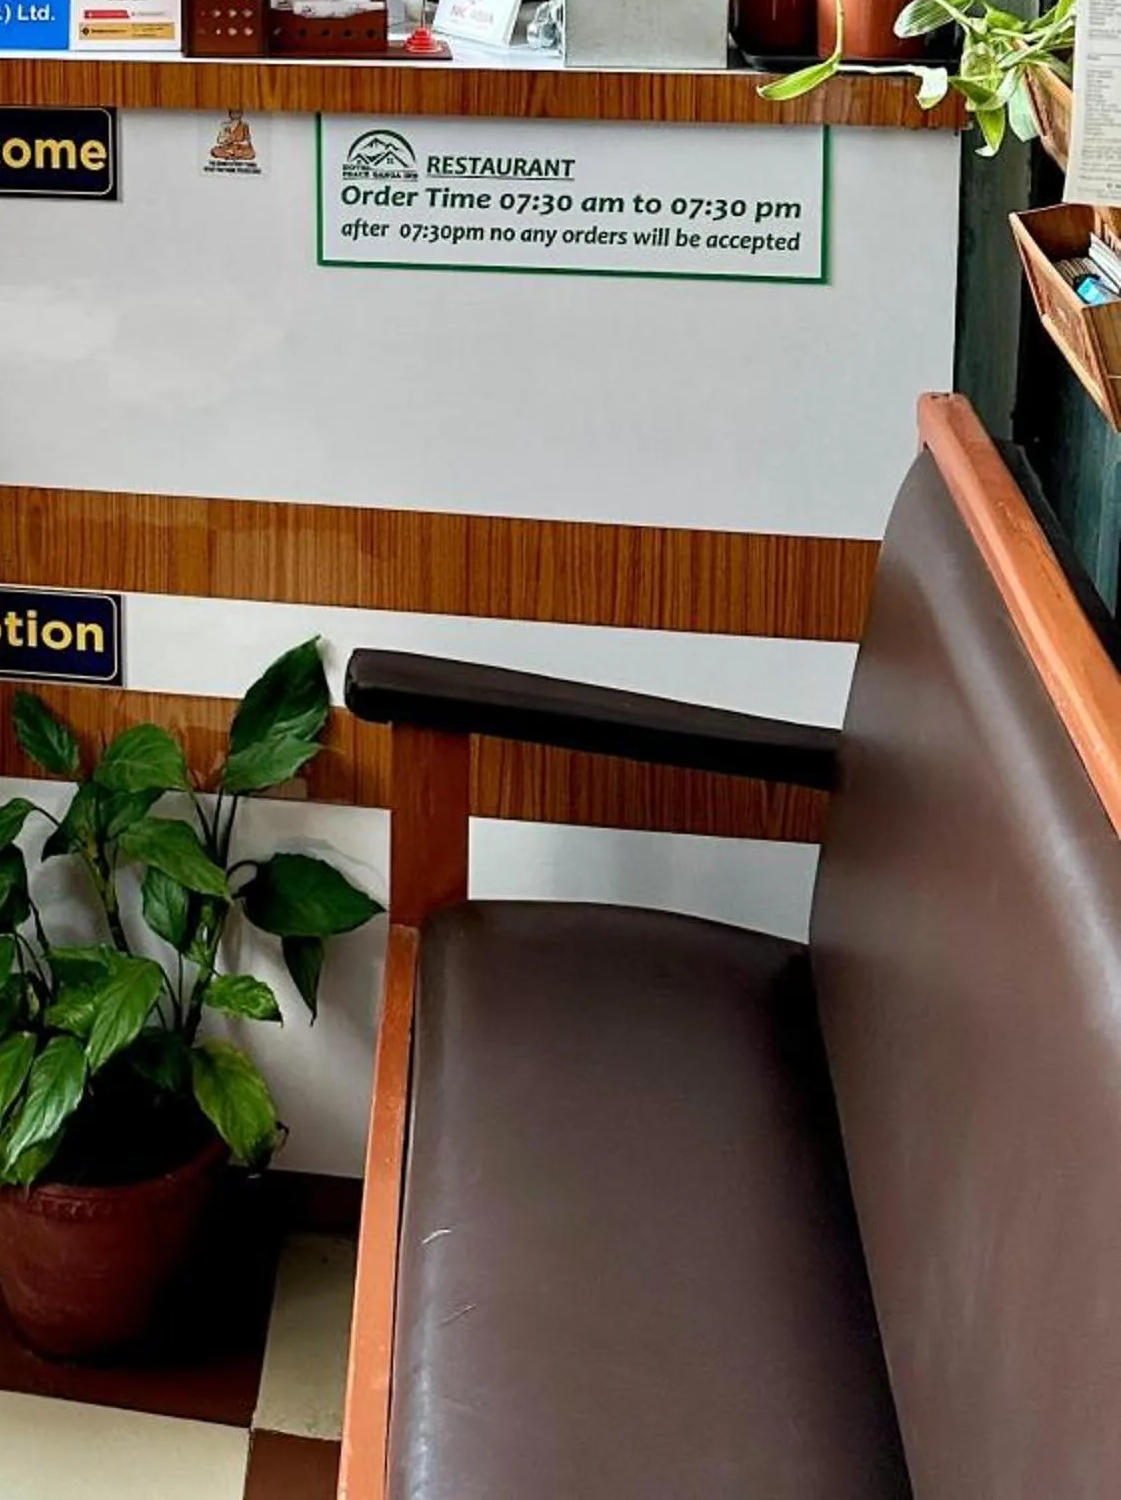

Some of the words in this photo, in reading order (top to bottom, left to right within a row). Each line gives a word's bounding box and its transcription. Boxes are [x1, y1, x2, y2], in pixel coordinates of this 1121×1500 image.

[17, 3, 56, 22] Ltd.
[426, 155, 576, 178] RESTAURANT
[340, 185, 419, 207] Order
[425, 187, 492, 209] Time
[499, 192, 574, 215] 07:30
[581, 195, 625, 213] am
[633, 193, 663, 214] to
[670, 198, 747, 221] 07:30
[754, 200, 802, 223] pm
[340, 217, 390, 241] after
[398, 222, 485, 245] 07:30pm
[489, 226, 516, 242] no
[520, 227, 558, 248] any
[562, 226, 628, 246] orders
[633, 226, 671, 247] will
[675, 227, 702, 248] be
[706, 231, 802, 255] accepted
